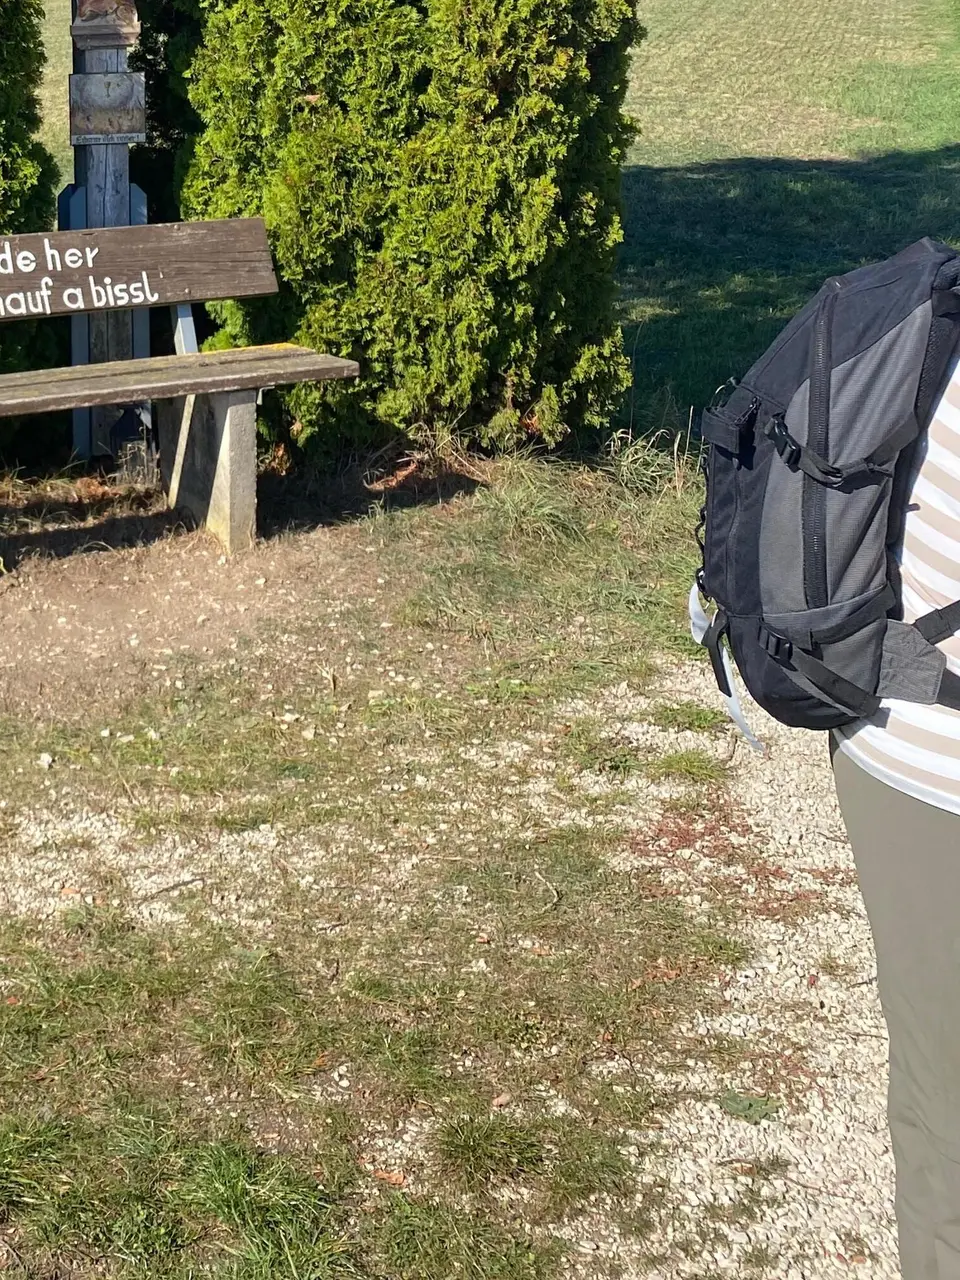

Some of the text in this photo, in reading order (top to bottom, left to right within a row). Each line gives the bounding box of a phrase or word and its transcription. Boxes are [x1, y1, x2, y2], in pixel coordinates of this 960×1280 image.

[43, 237, 99, 272] her
[62, 287, 85, 310] a
[88, 270, 159, 308] bissl
